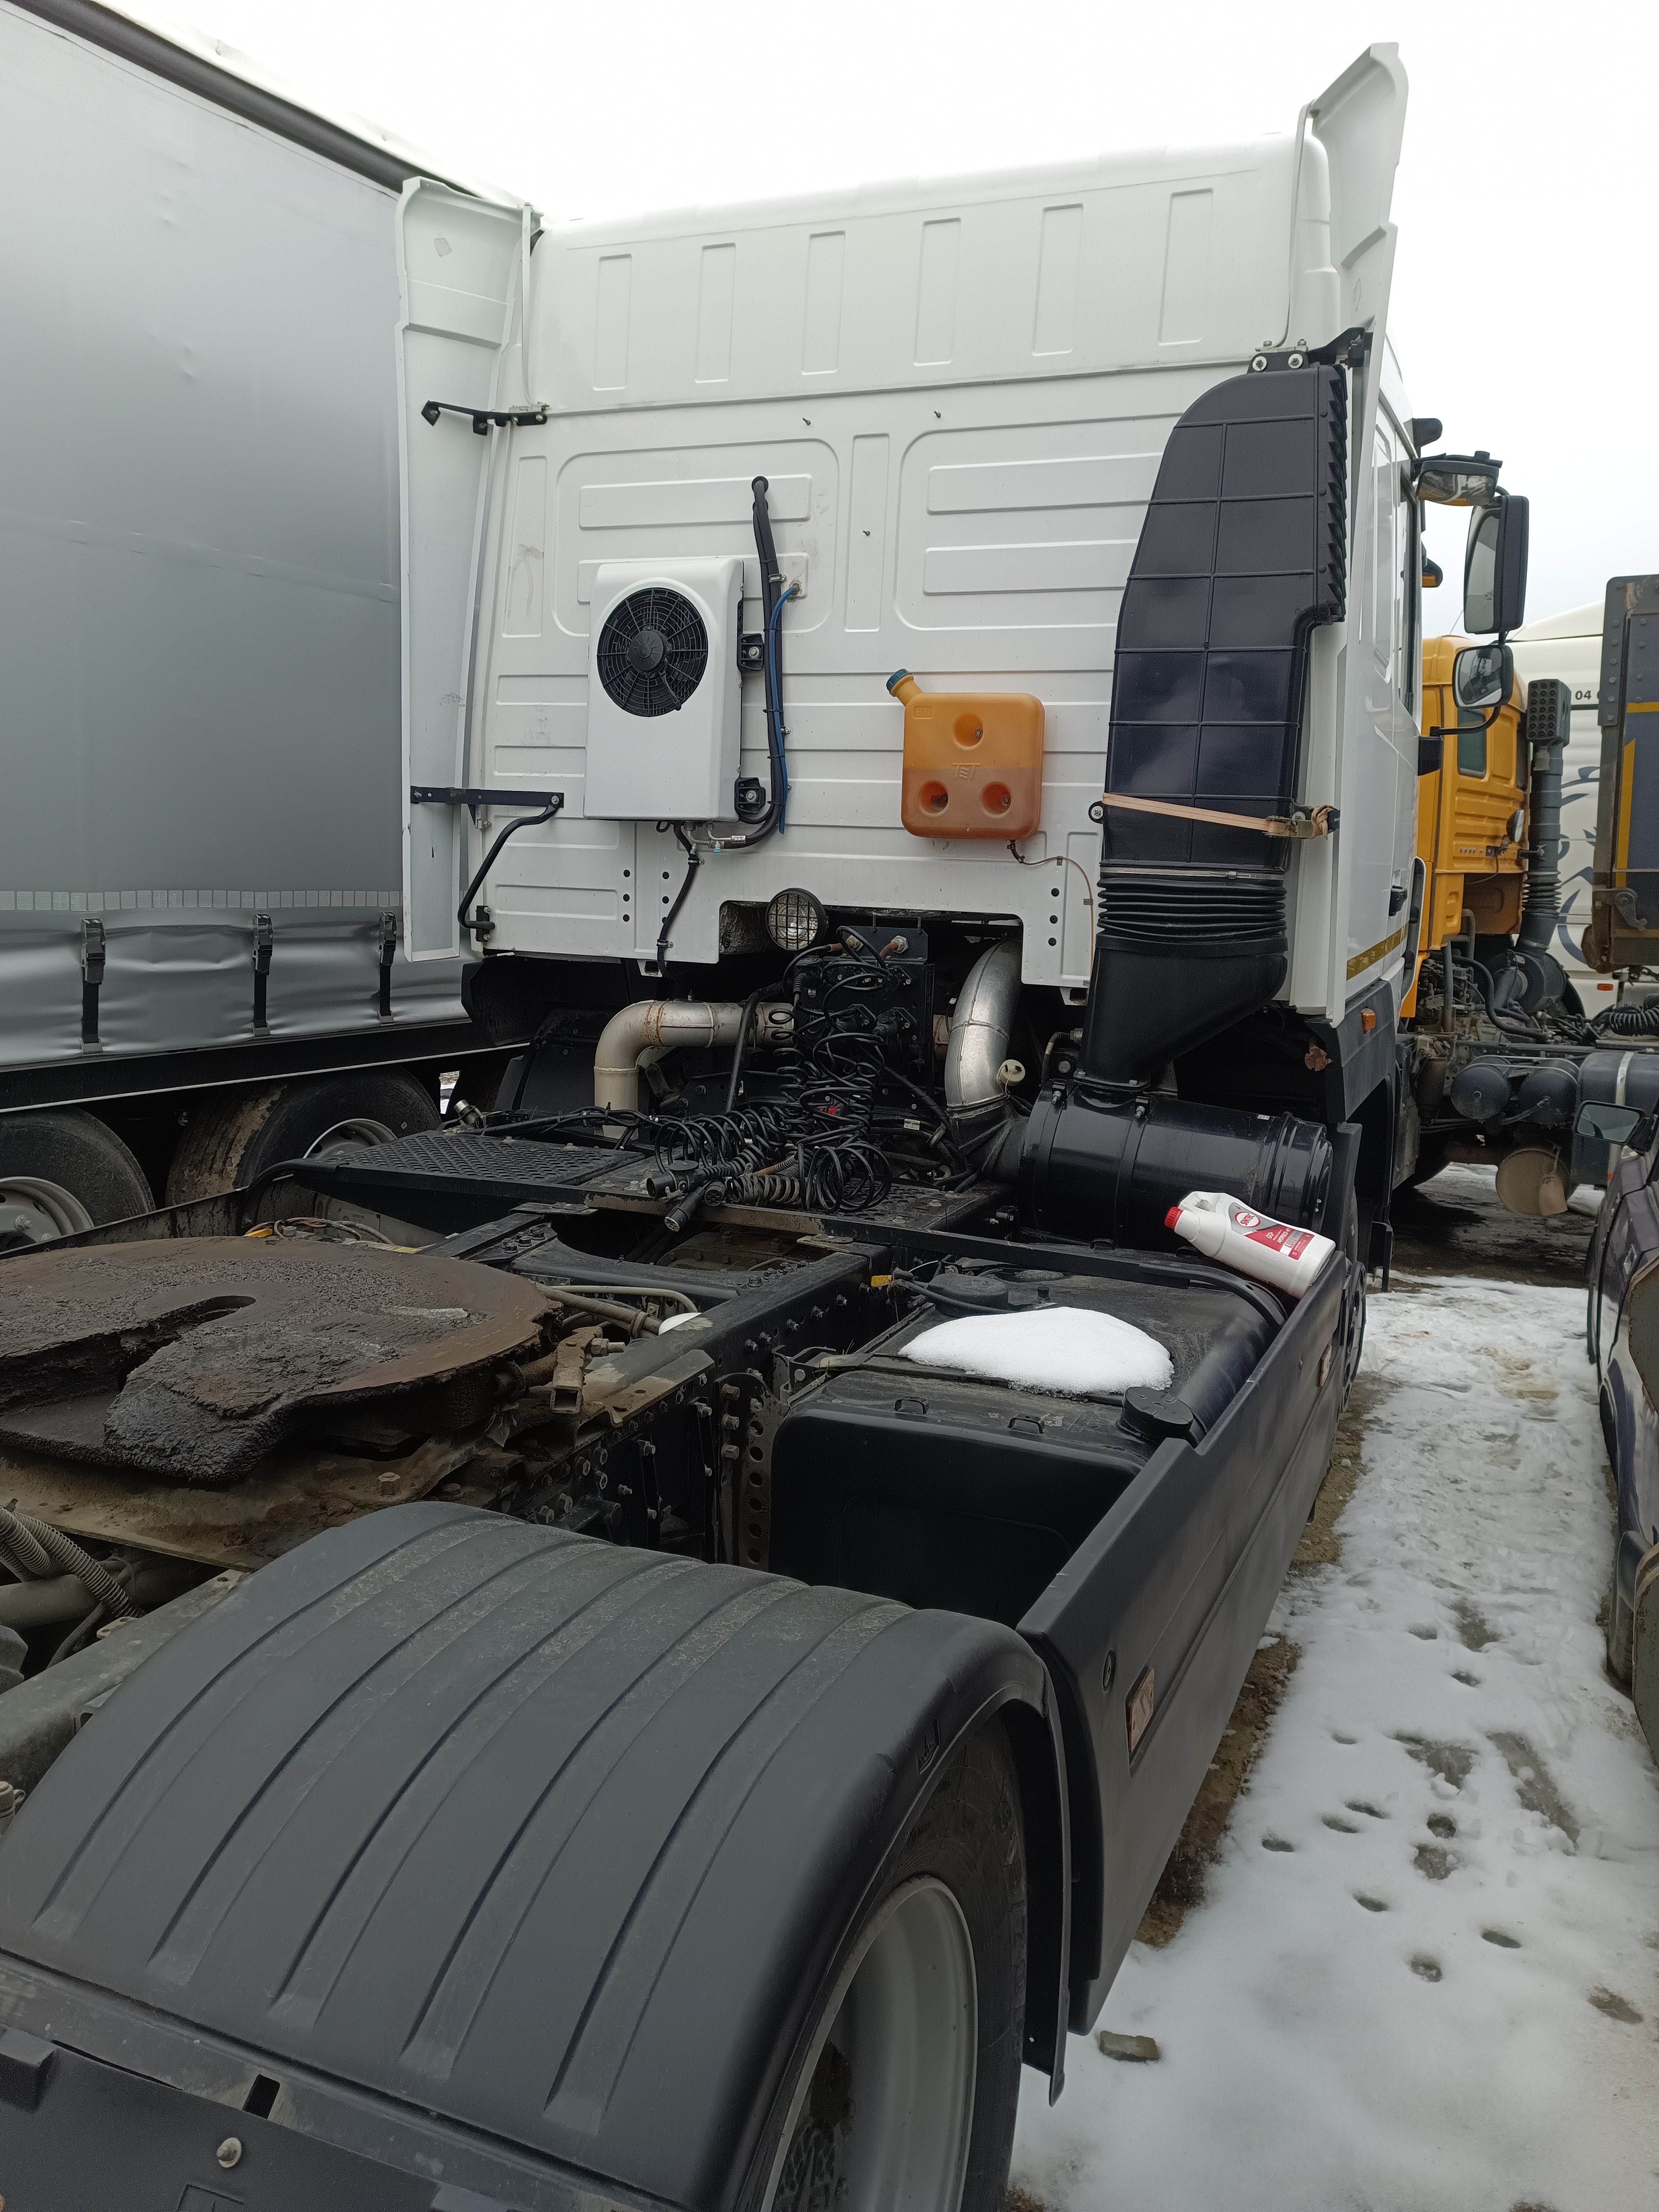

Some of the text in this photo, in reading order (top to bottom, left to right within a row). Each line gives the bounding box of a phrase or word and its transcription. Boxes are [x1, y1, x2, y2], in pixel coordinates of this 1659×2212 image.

[1575, 690, 1591, 700] 04
[1240, 1213, 1255, 1226] SINTEC
[1284, 1237, 1297, 1248] LUXE
